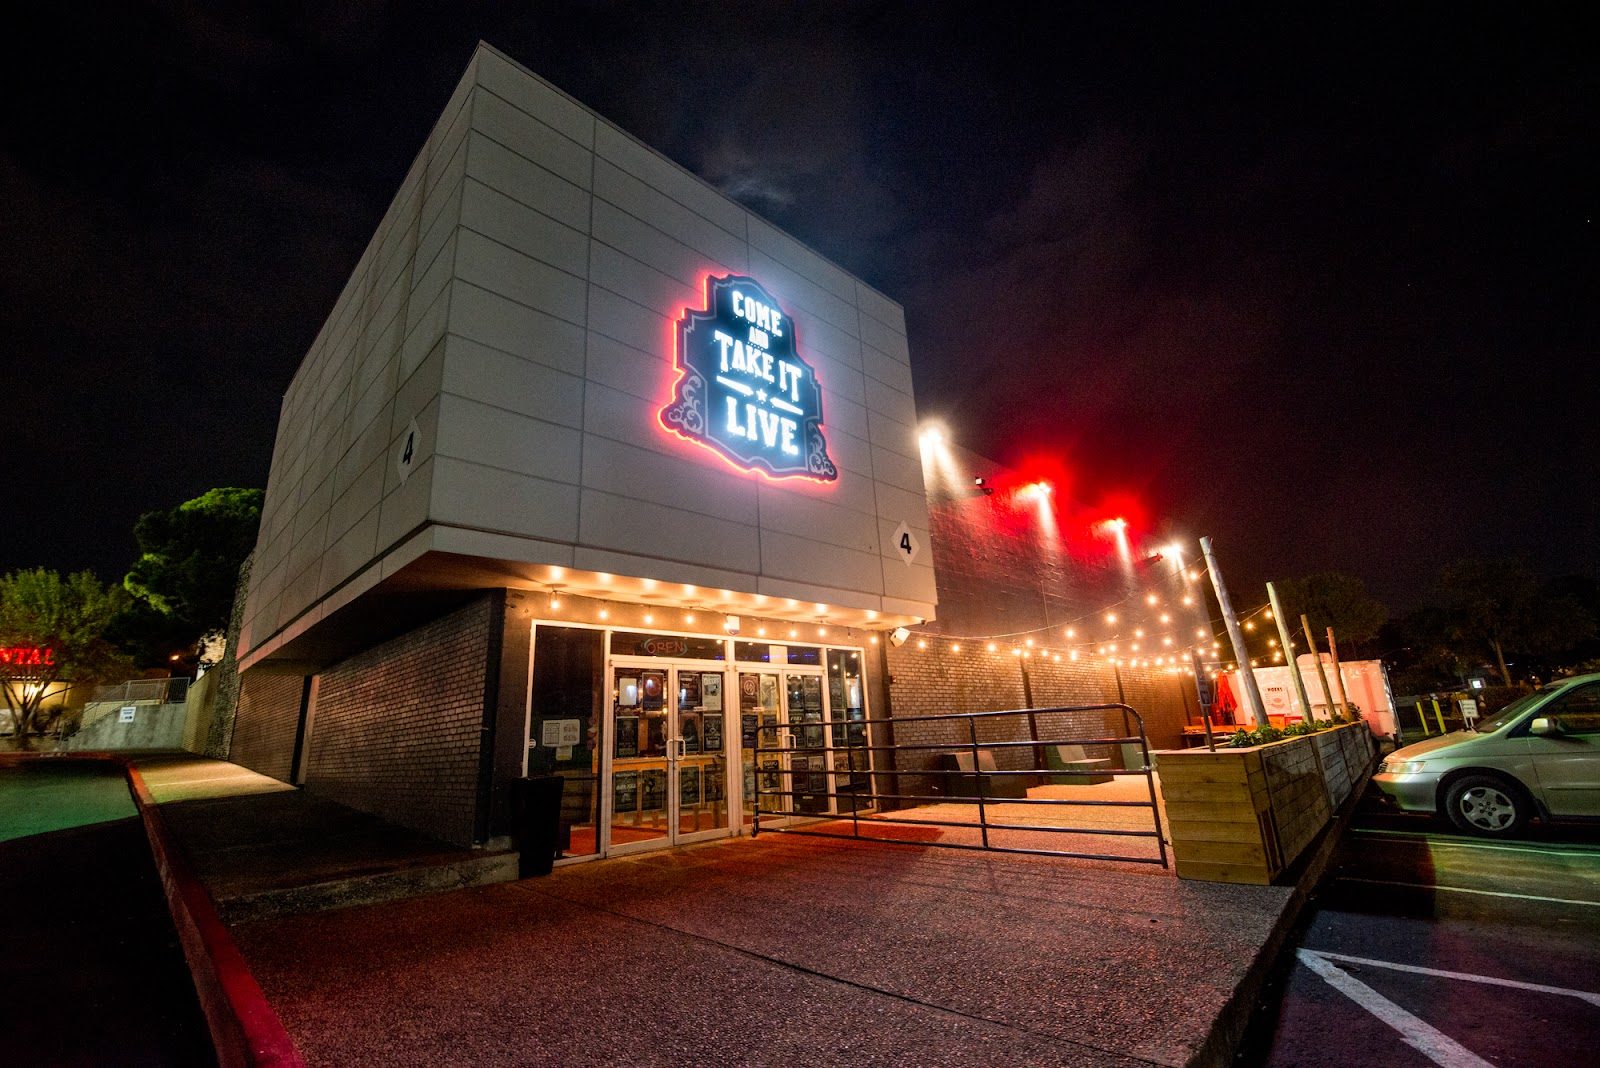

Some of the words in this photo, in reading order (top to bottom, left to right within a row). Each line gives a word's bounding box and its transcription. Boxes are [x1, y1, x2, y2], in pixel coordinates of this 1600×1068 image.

[732, 290, 783, 337] COME
[748, 325, 769, 349] AND
[714, 330, 775, 383] TAKE
[778, 359, 802, 402] IT
[726, 396, 798, 455] LIVE
[402, 431, 414, 464] 4
[900, 532, 911, 554] 4
[647, 641, 683, 654] OPEN
